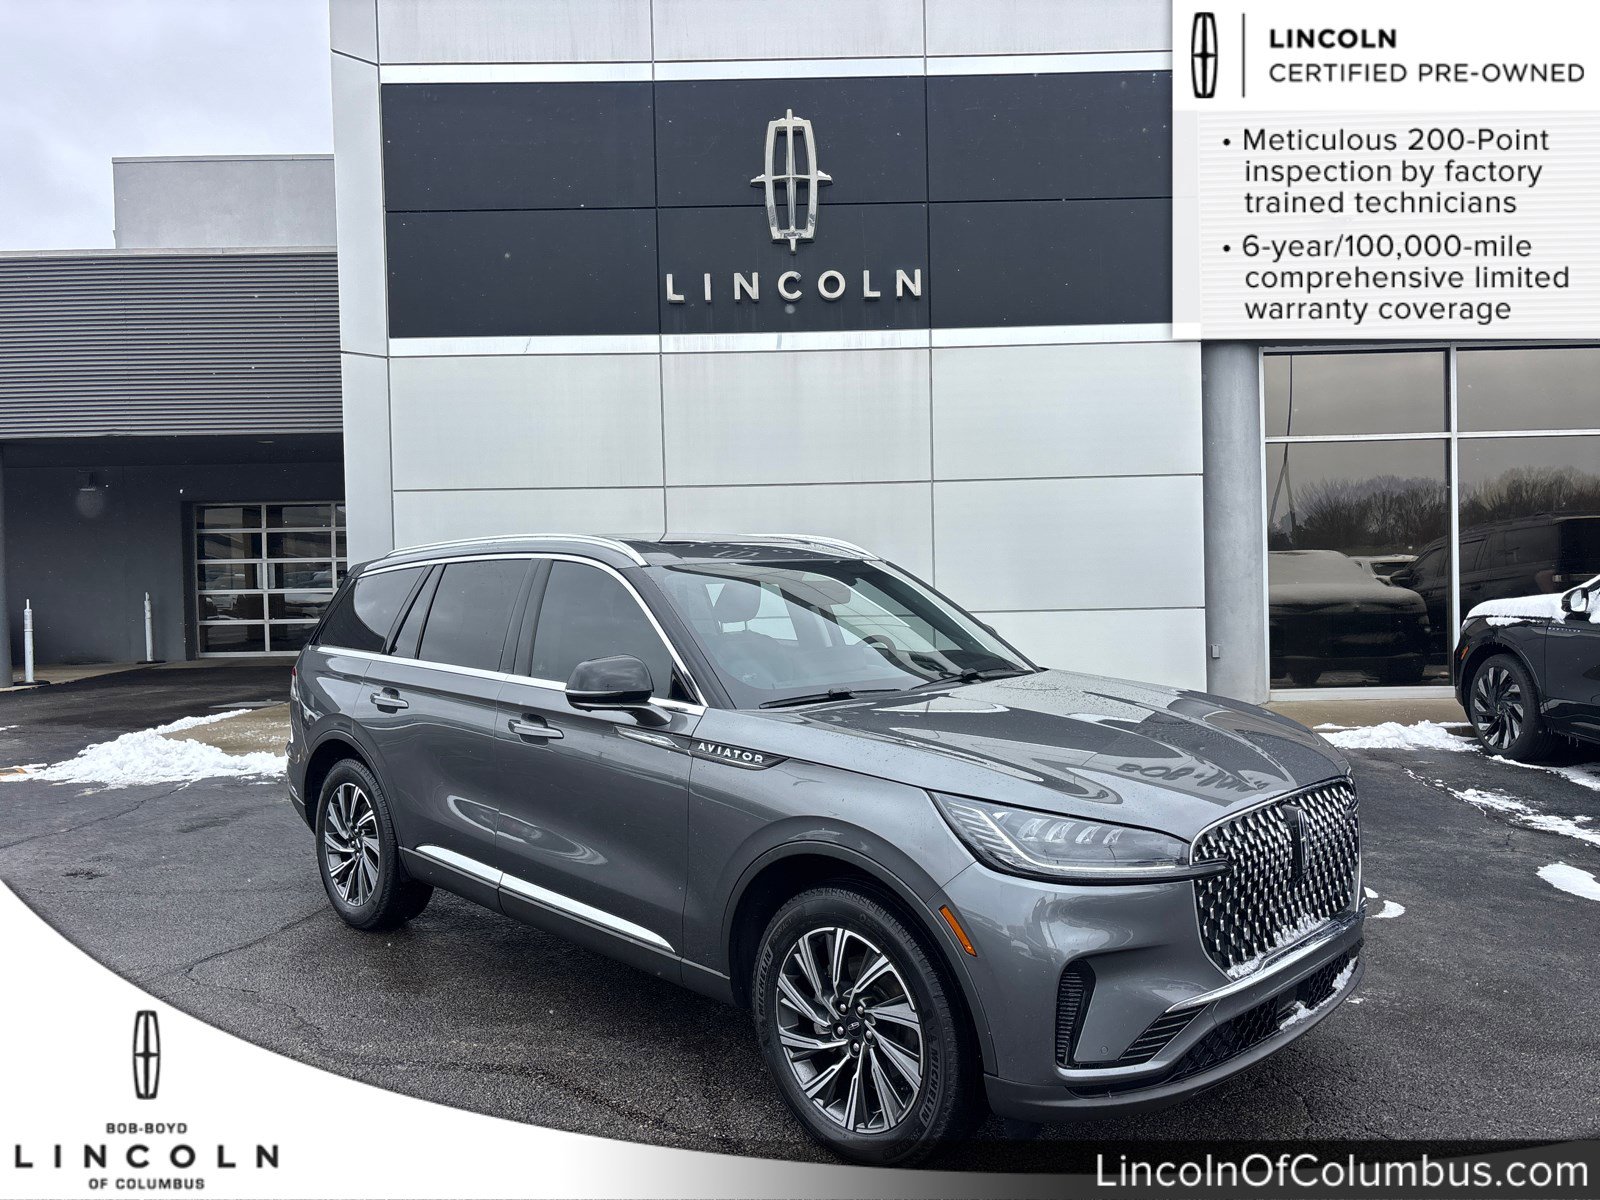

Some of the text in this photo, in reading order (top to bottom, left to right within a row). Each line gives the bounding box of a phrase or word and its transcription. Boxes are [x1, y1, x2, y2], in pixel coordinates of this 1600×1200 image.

[666, 268, 922, 304] LINCOLN
[698, 742, 763, 764] AVIATOR
[757, 948, 772, 1016] MICHELIN
[921, 1047, 939, 1122] MICHELIN
